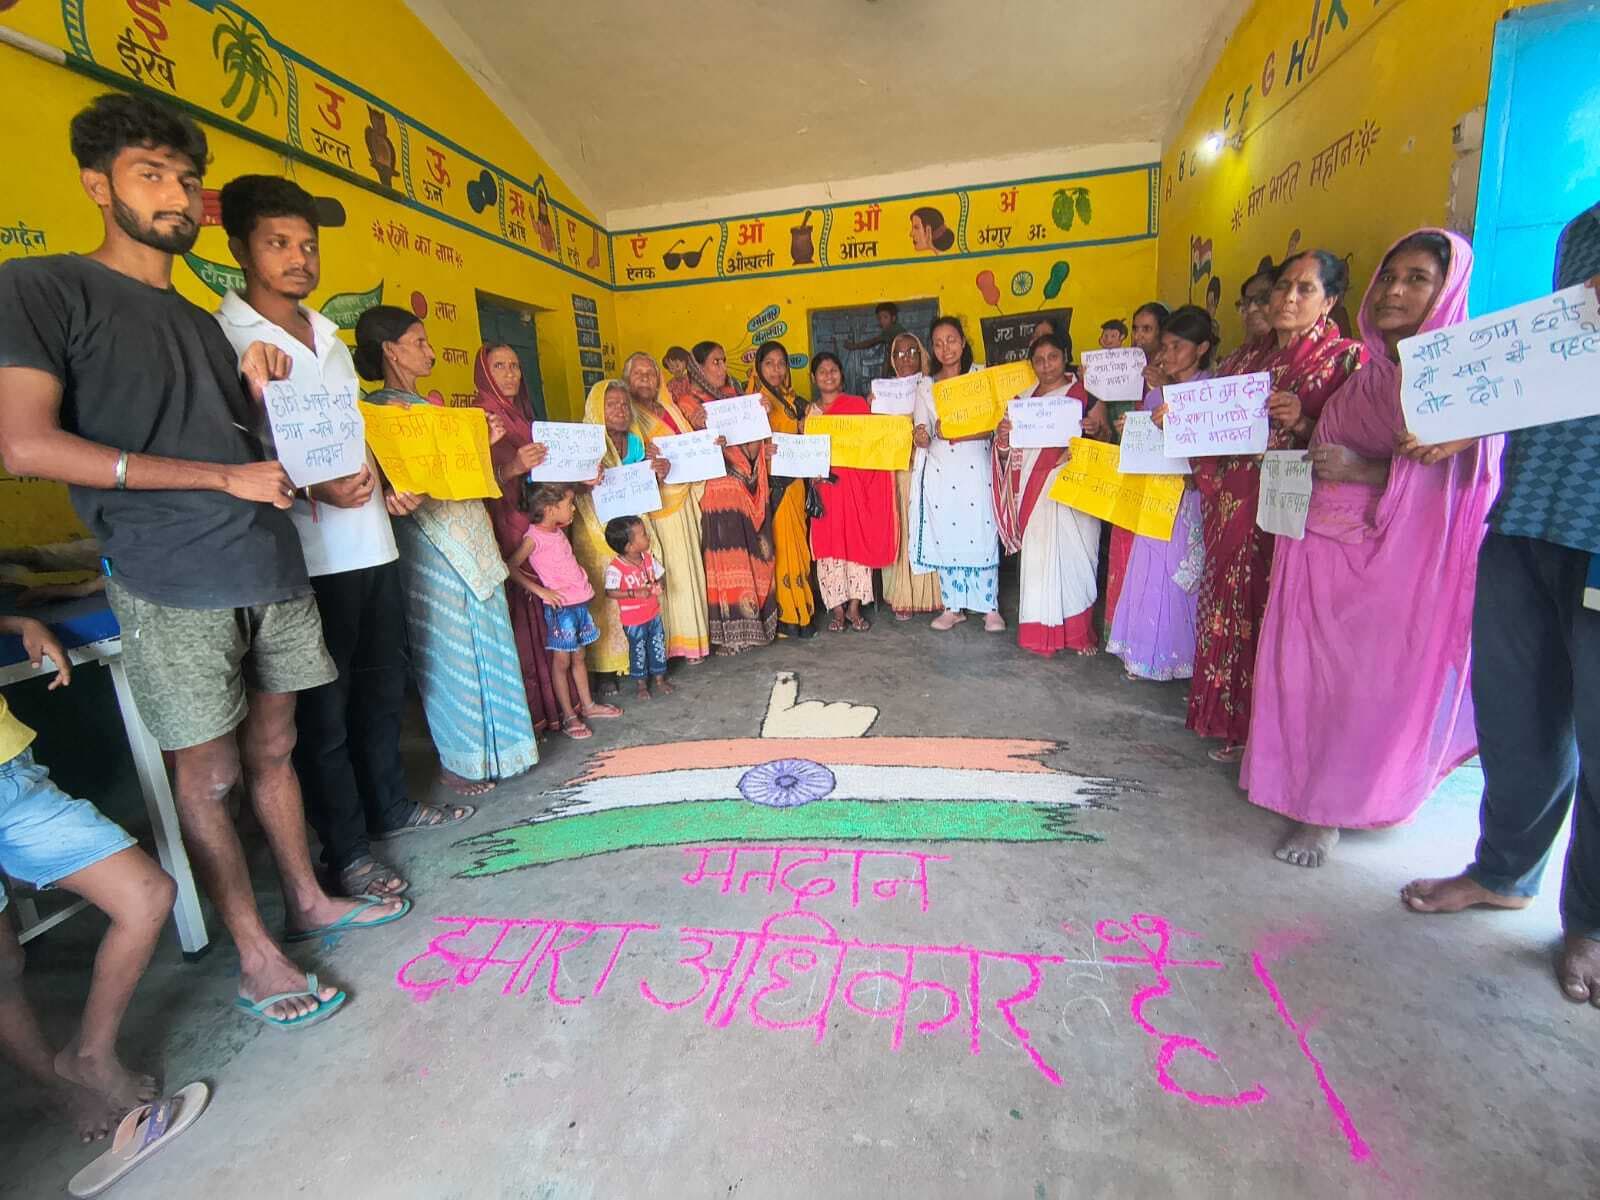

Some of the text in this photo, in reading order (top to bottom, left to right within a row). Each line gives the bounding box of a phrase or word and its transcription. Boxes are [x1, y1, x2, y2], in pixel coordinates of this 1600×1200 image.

[1261, 49, 1275, 97] G
[1269, 160, 1302, 202] भारत
[1310, 130, 1354, 192] महान
[415, 234, 432, 257] का
[434, 302, 457, 322] लाल
[681, 846, 953, 913] मतदान
[396, 915, 660, 1007] हमारा
[640, 911, 1064, 1087] अधिकार
